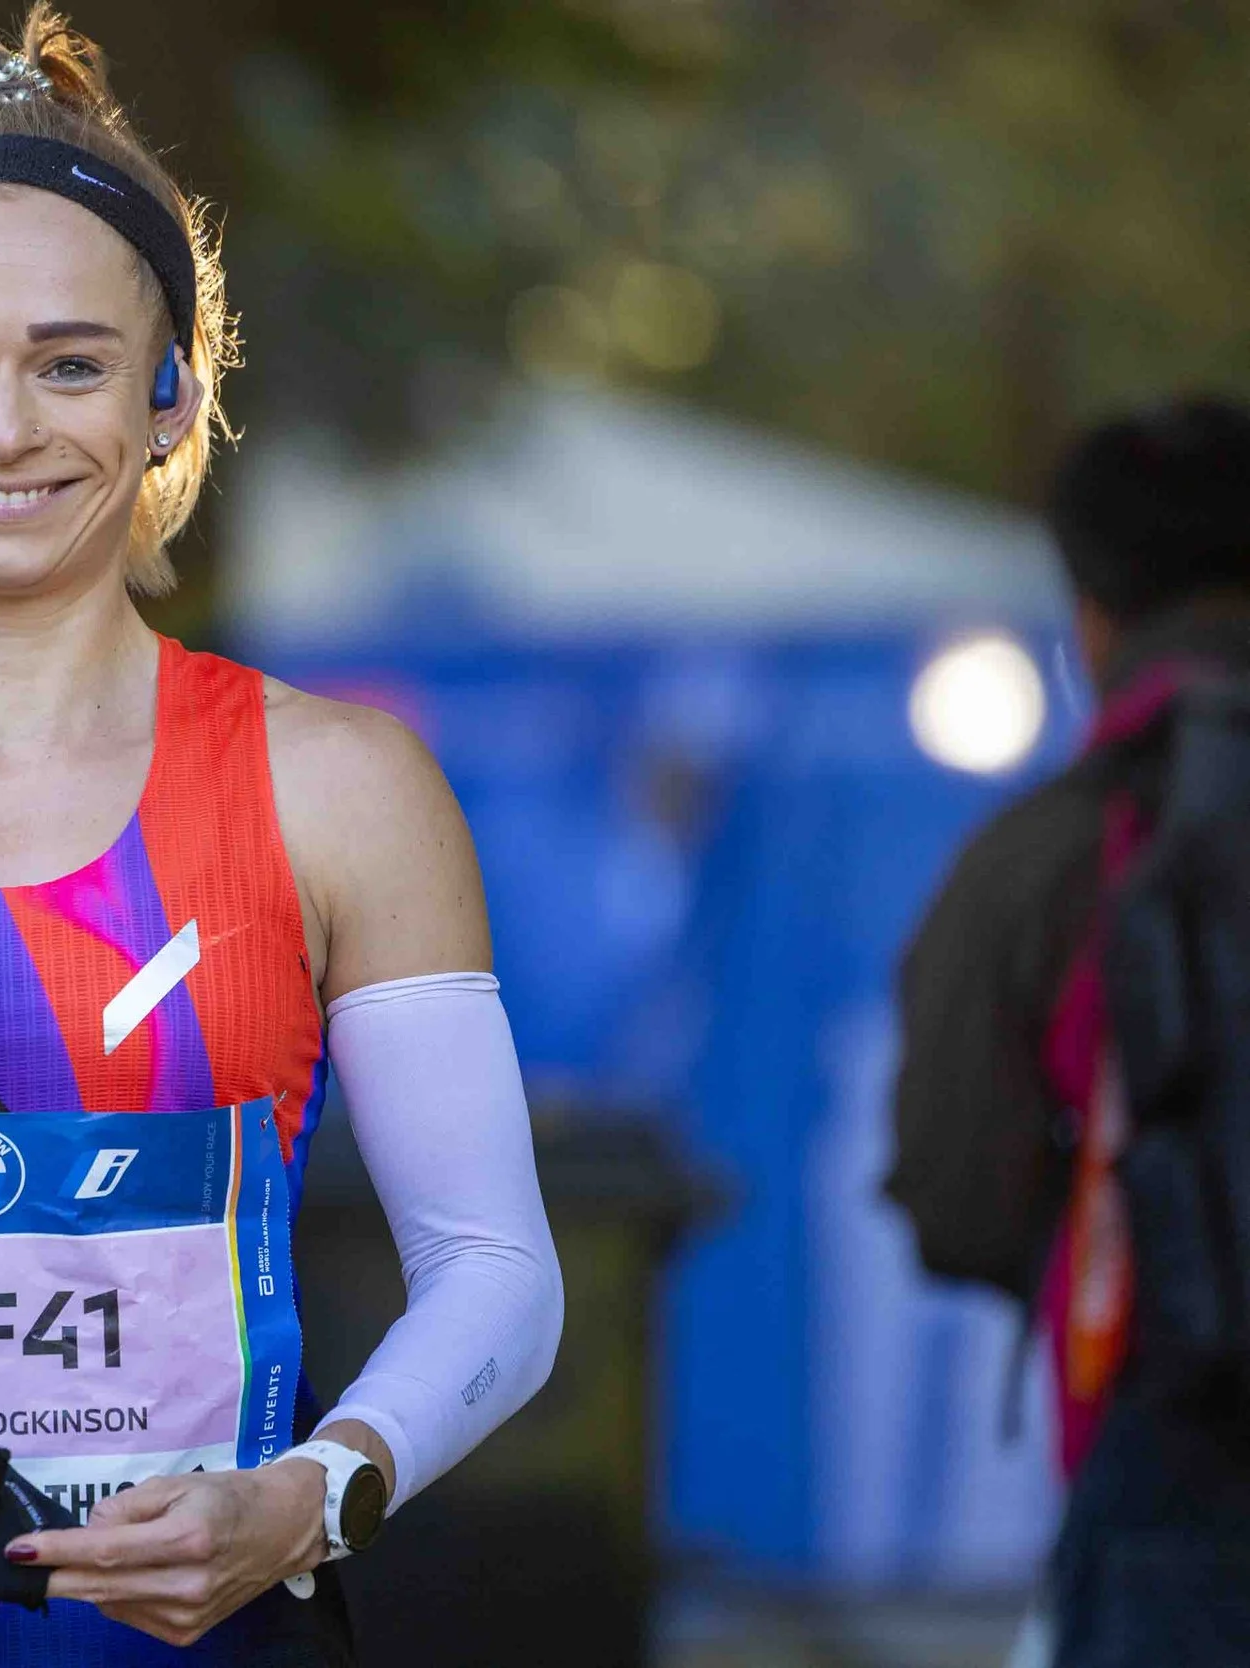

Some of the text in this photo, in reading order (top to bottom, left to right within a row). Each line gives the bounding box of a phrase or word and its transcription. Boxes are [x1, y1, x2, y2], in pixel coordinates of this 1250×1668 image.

[206, 1120, 217, 1150] RACE
[204, 1152, 215, 1180] YOUR
[263, 1364, 282, 1431] EVENTS
[44, 1481, 136, 1527] TH
